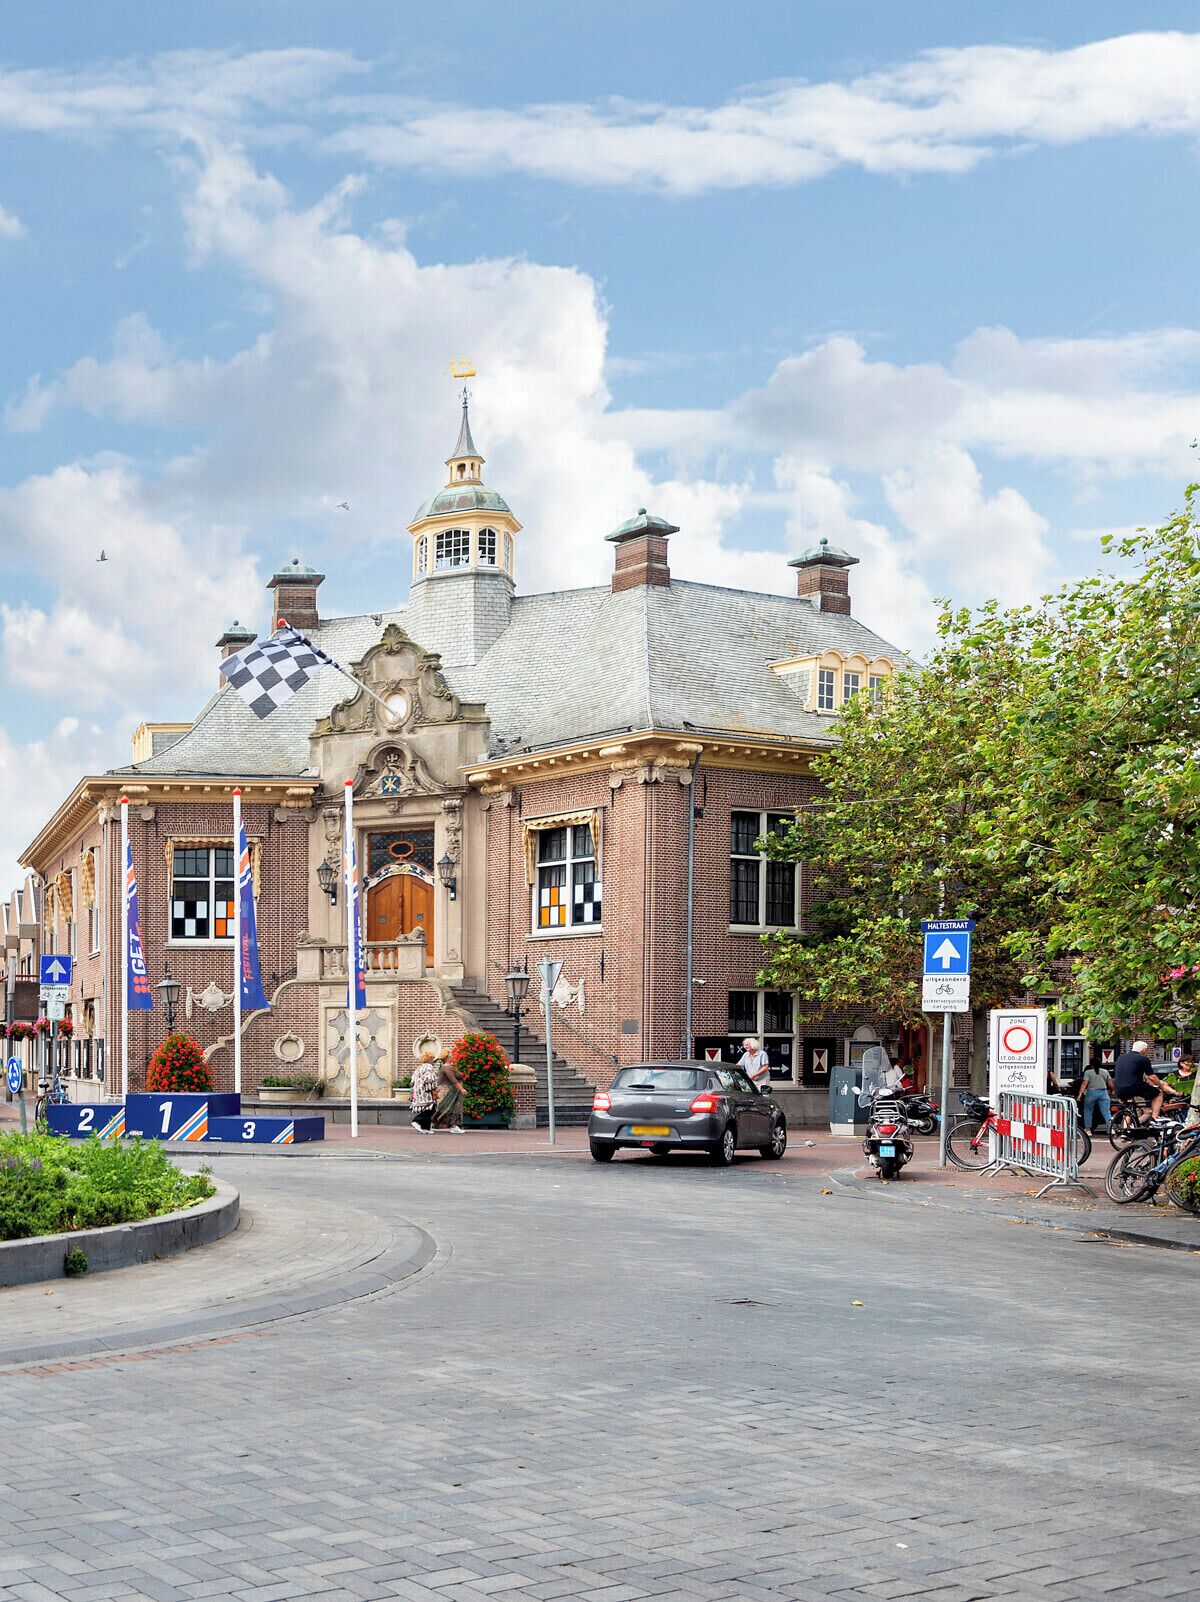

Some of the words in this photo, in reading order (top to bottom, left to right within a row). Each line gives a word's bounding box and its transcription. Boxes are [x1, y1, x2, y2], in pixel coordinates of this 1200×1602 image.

[927, 922, 968, 930] HALTESTRAAT
[129, 928, 146, 975] GET
[77, 1108, 95, 1131] 2
[158, 1101, 173, 1134] 1
[241, 1121, 256, 1139] 3
